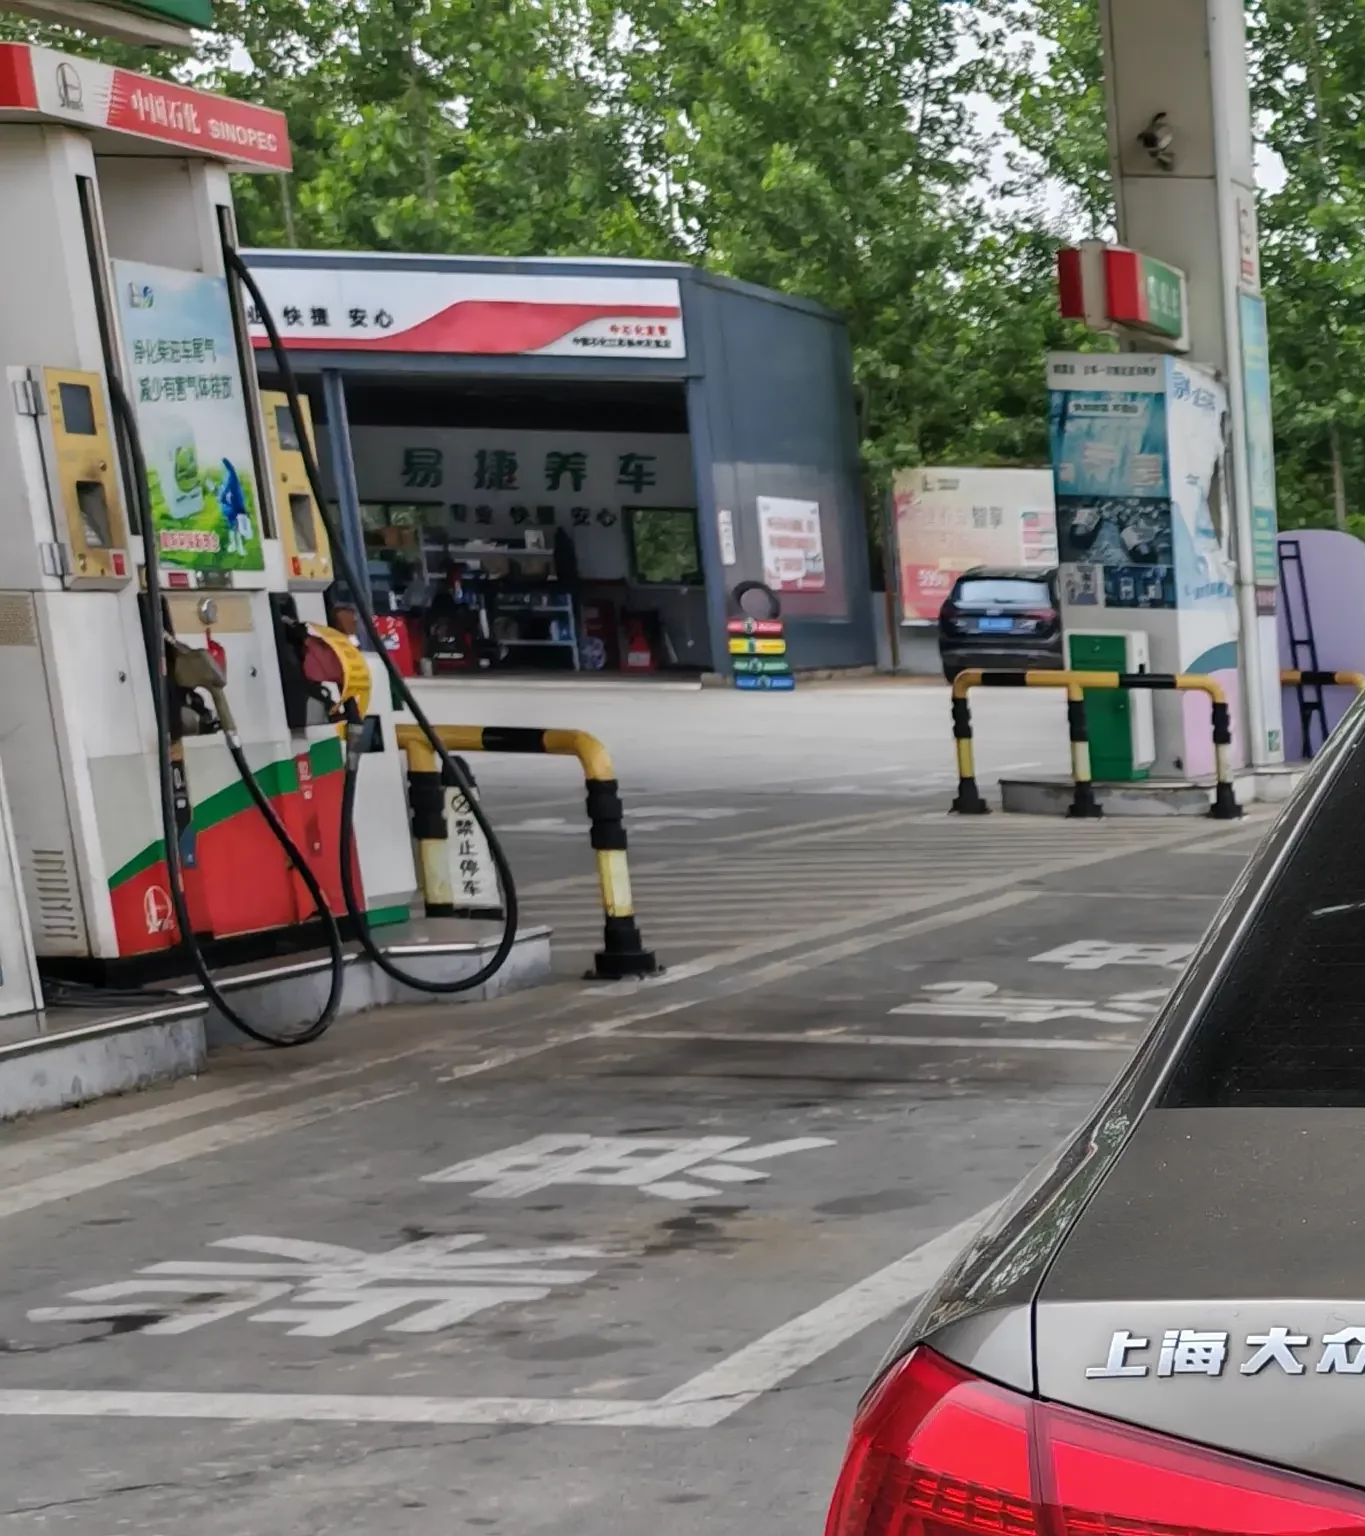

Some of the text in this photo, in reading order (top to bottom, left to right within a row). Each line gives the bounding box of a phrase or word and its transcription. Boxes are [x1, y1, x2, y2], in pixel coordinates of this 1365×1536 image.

[207, 118, 278, 152] SINOPEC
[348, 307, 394, 329] 安心
[400, 447, 658, 495] 易捷养车
[455, 819, 482, 897] 禁止停车
